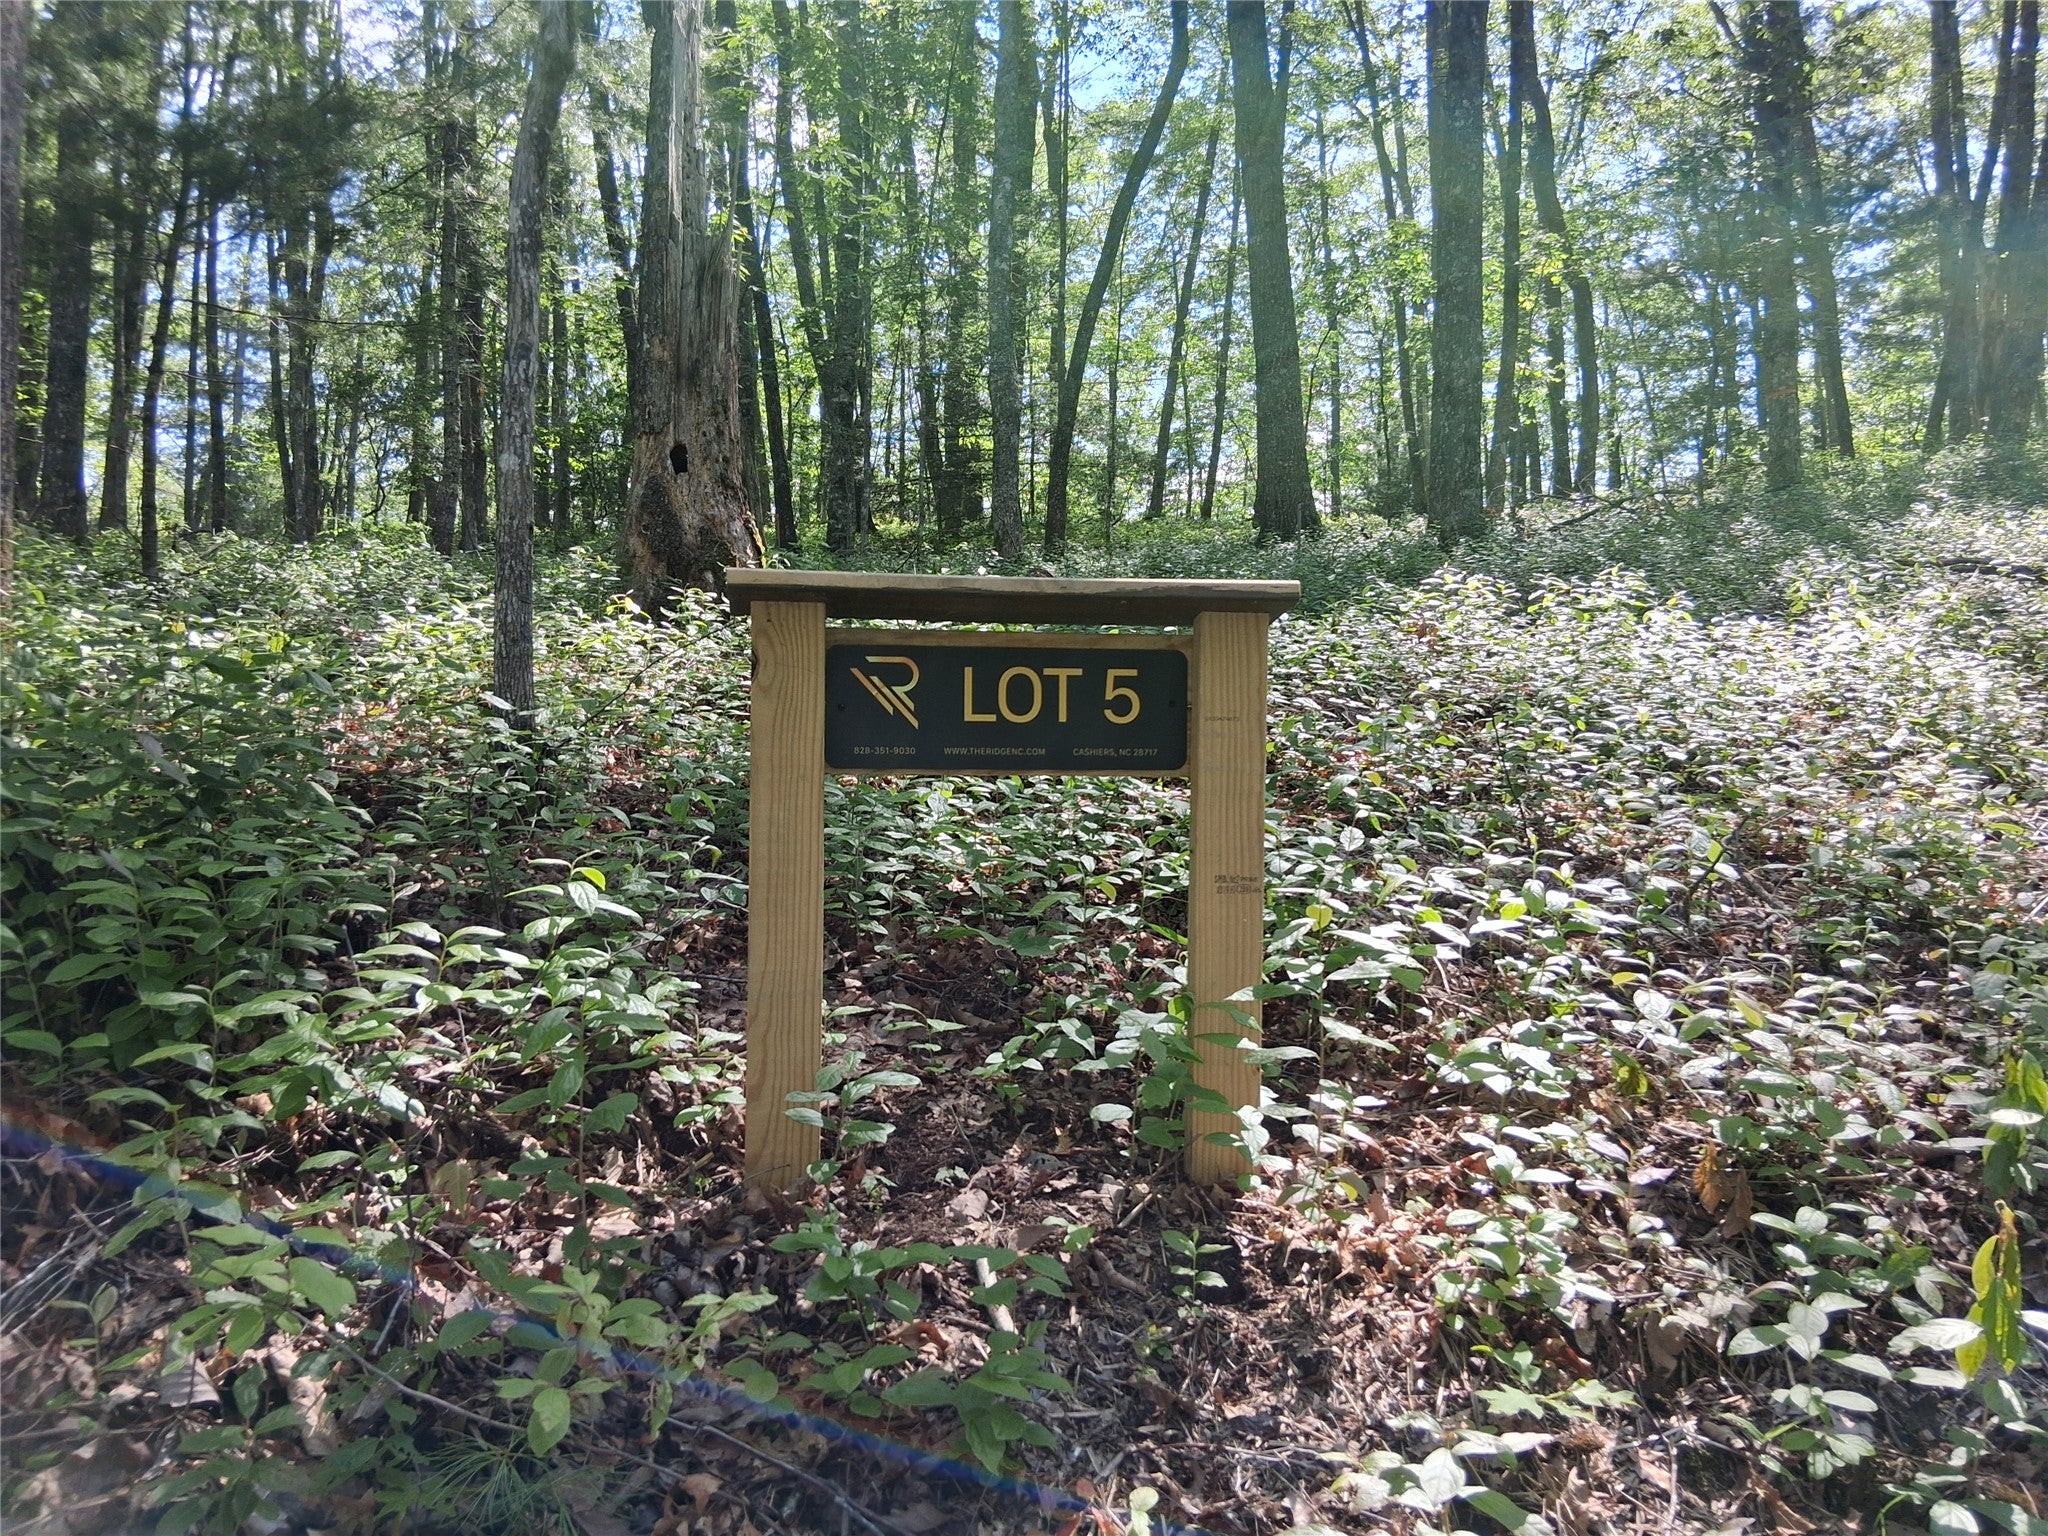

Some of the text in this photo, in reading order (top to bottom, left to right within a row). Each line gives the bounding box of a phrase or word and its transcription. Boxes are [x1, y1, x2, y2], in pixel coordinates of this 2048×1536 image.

[963, 666, 1142, 725] LOT 5
[853, 746, 917, 756] 828-351-9030
[943, 747, 1046, 757] WWW.THERIDGENC.COM
[1072, 748, 1159, 758] CASHIERS, NC 28717
